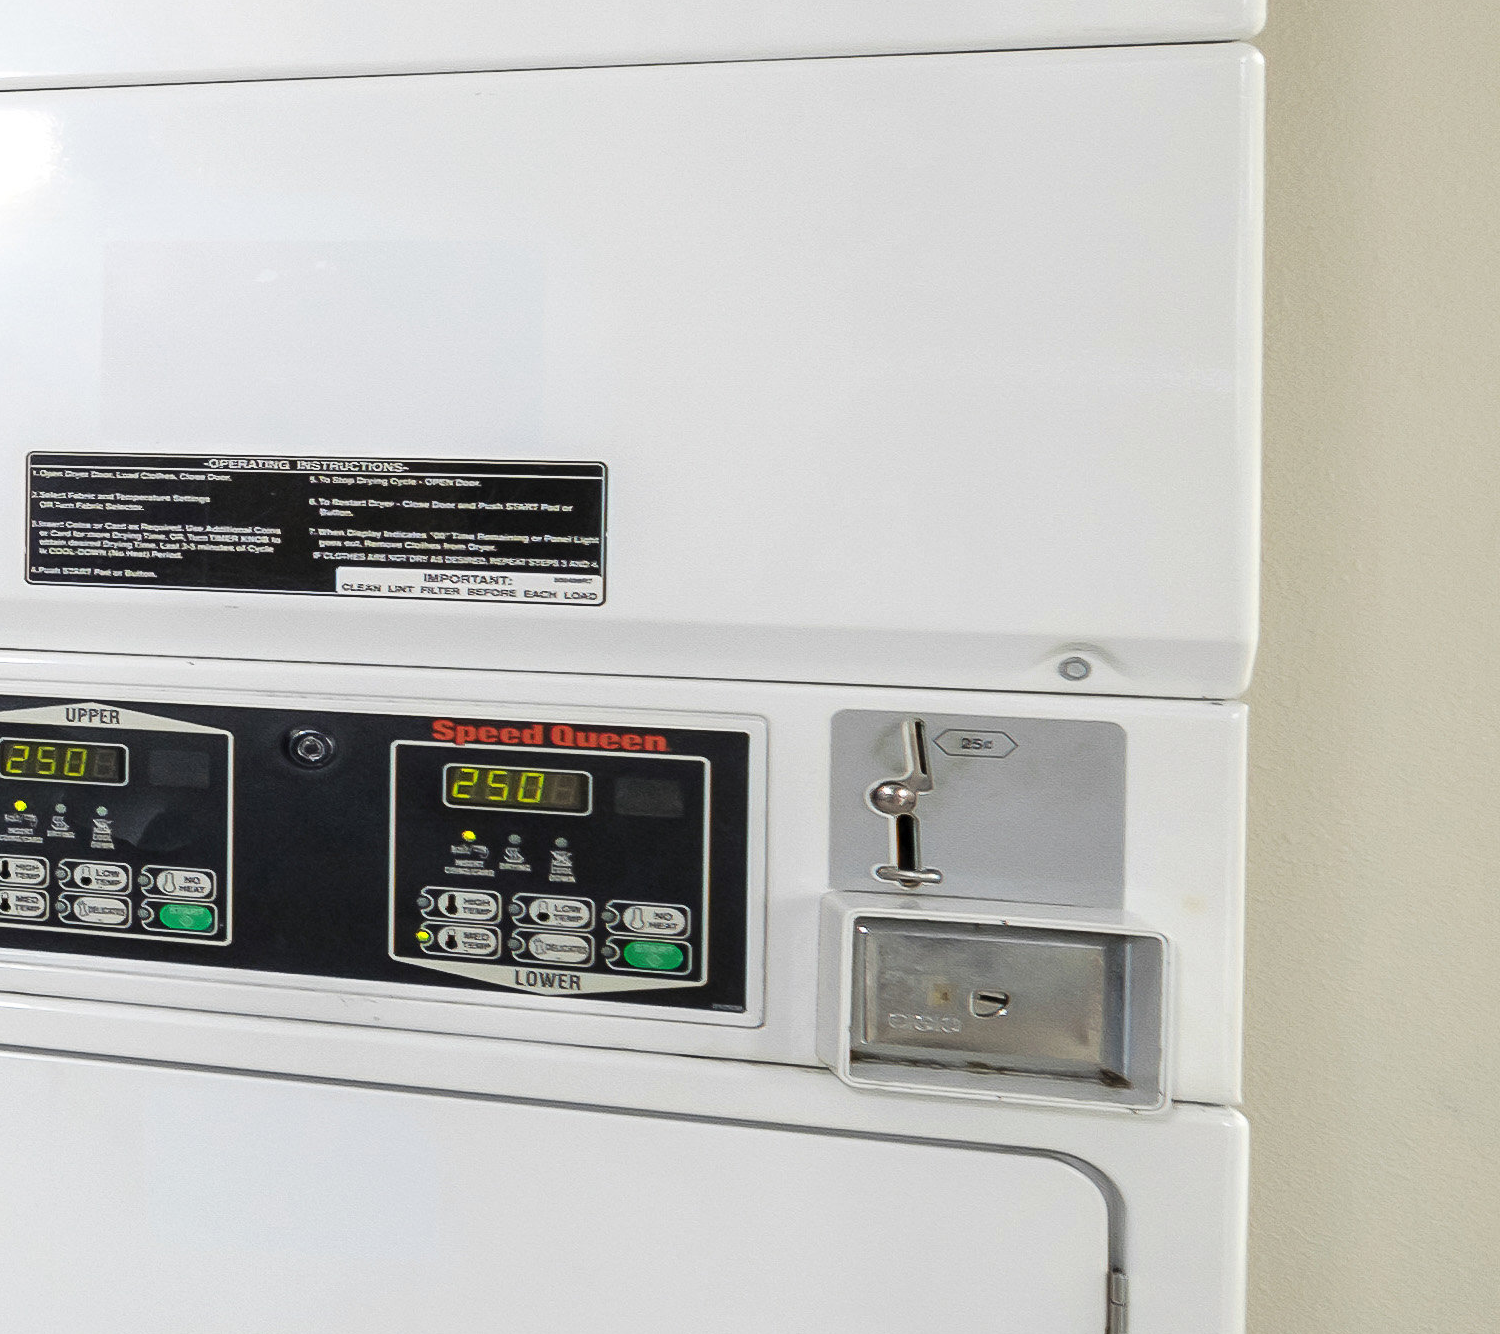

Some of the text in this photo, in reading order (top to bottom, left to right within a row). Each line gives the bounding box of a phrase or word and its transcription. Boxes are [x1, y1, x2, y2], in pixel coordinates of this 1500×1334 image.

[423, 573, 513, 586] IMPORTANT:
[341, 583, 598, 601] CLEAN LINT FILTER BEFORE EACH LOAD
[65, 707, 120, 724] UPPER
[432, 719, 668, 752] Speed Queen
[514, 969, 582, 991] LOWER
